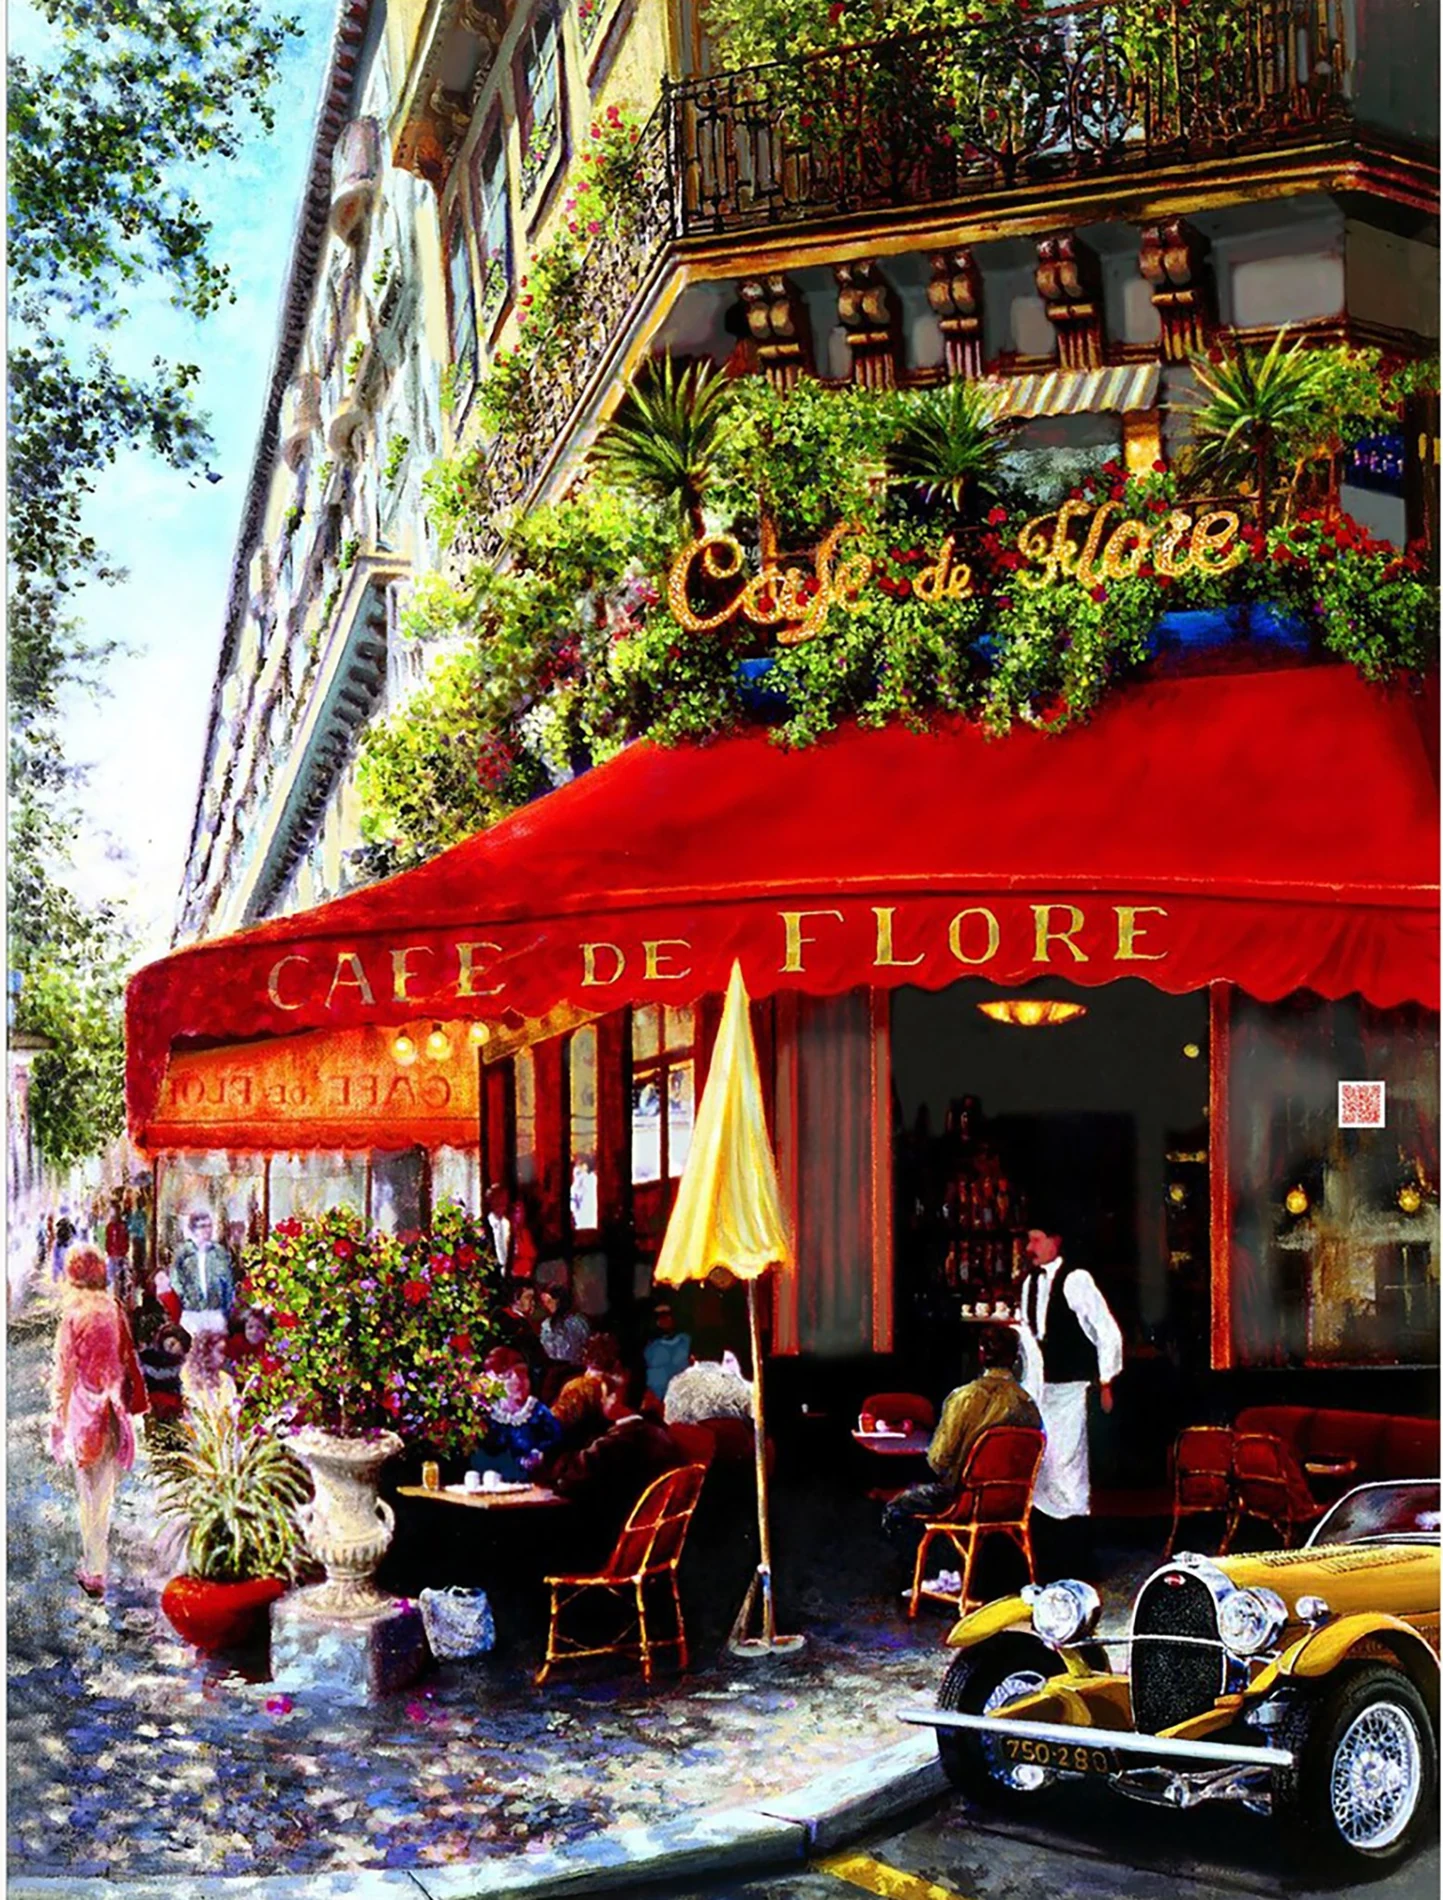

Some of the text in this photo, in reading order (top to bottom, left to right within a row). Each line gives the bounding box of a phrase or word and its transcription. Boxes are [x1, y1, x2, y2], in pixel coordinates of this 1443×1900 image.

[912, 534, 973, 601] de
[1016, 498, 1240, 590] Flore
[267, 904, 1169, 1011] CAFE DE FLORE
